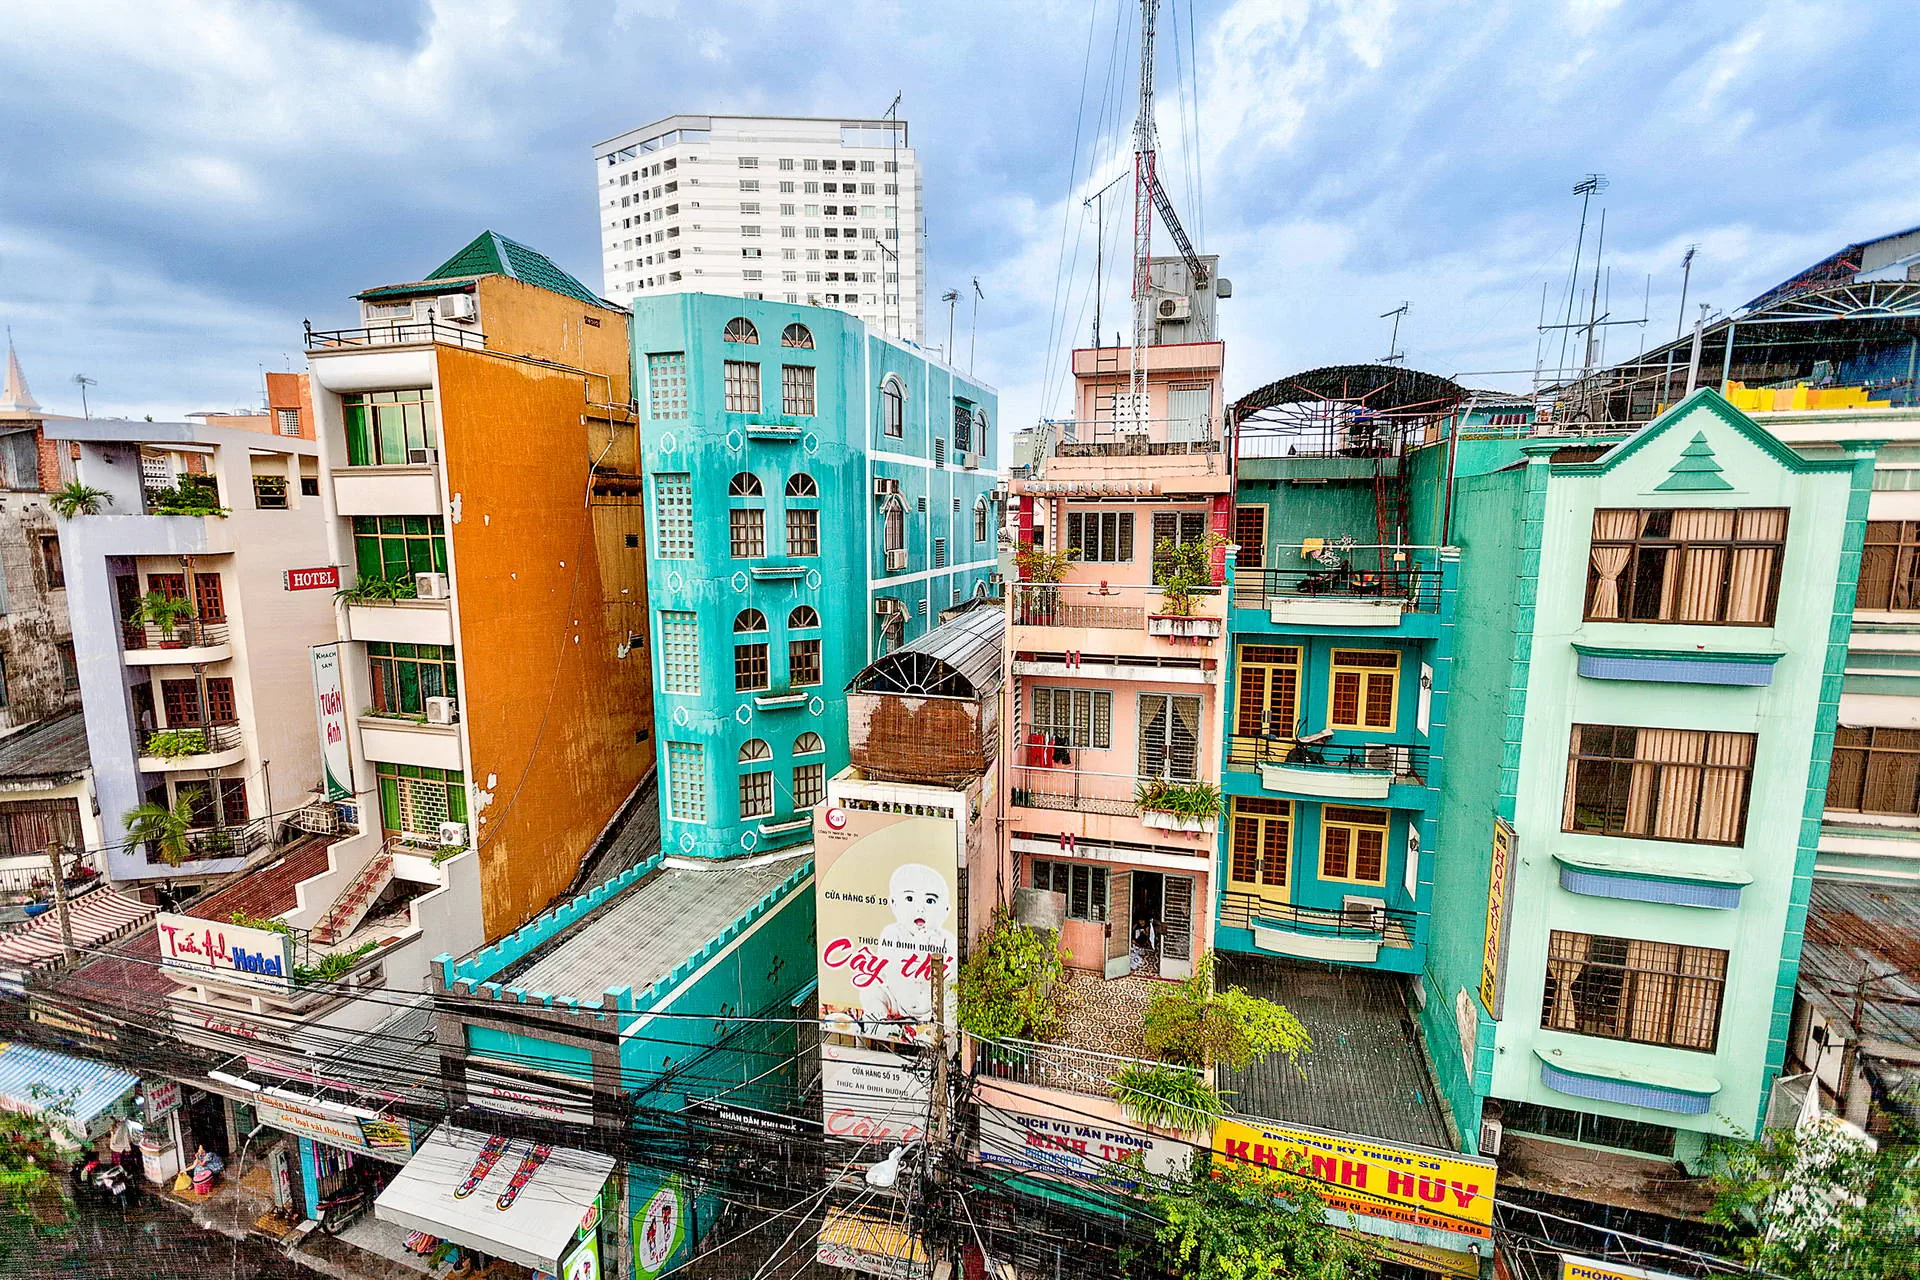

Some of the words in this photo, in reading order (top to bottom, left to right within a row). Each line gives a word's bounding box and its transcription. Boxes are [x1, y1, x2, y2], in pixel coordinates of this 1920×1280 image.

[293, 571, 335, 587] HOTEL
[1487, 847, 1501, 898] HOA
[825, 889, 841, 901] CỬA
[842, 892, 864, 904] HÀNG
[865, 892, 876, 904] SỐ
[878, 896, 888, 905] 19
[231, 946, 283, 977] Hotel
[823, 938, 889, 988] Cây
[865, 1068, 882, 1079] HÀNG
[892, 1073, 900, 1081] 19
[284, 1102, 302, 1114] kinh
[302, 1108, 327, 1121] doanh
[341, 1131, 363, 1144] trang
[1016, 1116, 1051, 1130] DỊCH
[1052, 1122, 1071, 1136] VỤ
[1074, 1126, 1101, 1140] VĂN
[1105, 1132, 1154, 1150] PHÒNG
[1025, 1131, 1088, 1157] MINH
[1387, 1171, 1480, 1209] HUY
[1395, 1212, 1416, 1222] FILE
[1458, 1224, 1483, 1235] CARD
